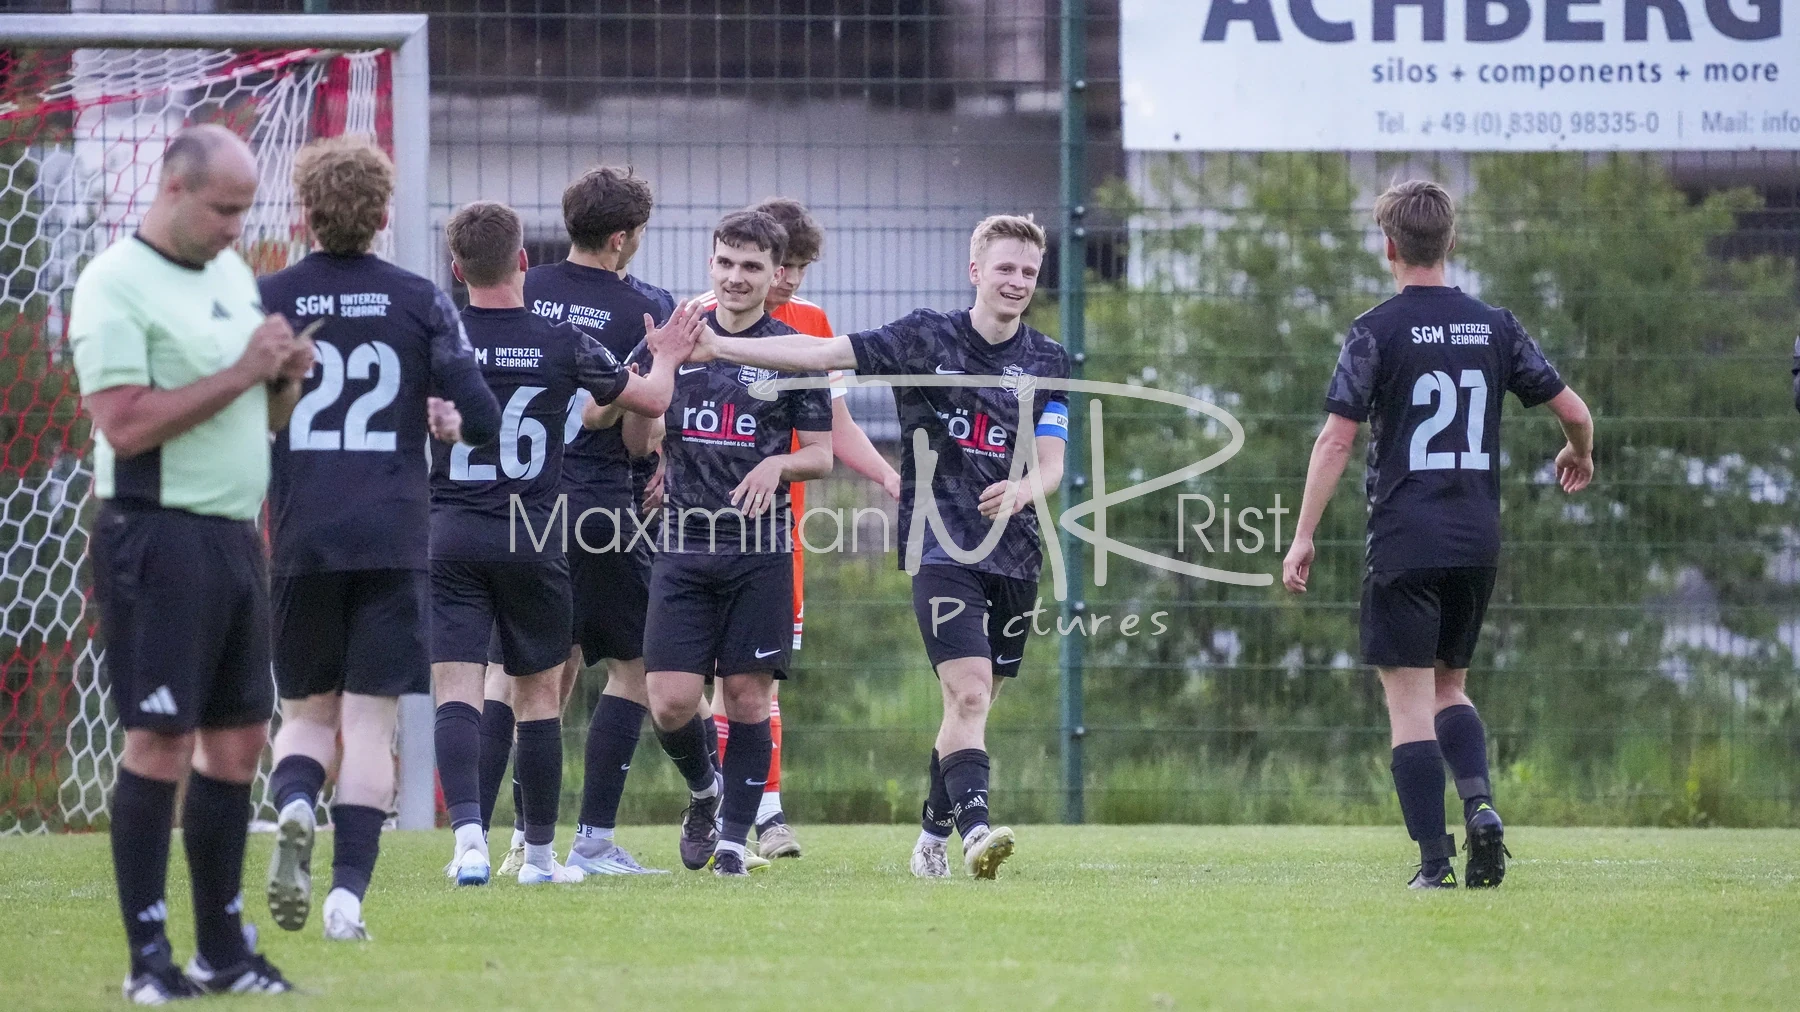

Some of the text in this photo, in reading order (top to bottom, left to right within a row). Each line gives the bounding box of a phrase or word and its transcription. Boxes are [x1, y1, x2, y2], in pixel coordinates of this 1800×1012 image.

[1201, 0, 1783, 42] ACHBERG
[1371, 57, 1780, 89] silos + components + more
[1508, 111, 1562, 134] 8380
[1570, 111, 1659, 134] 98335-0
[296, 294, 335, 316] SGM
[340, 292, 391, 306] UNTERZEIL
[531, 299, 564, 320] SGM
[569, 304, 611, 321] UNTERZEIL
[566, 314, 605, 330] SEIBRANZ
[1449, 323, 1492, 335] UNTERZEIL
[1411, 325, 1445, 344] SGM
[1450, 334, 1489, 346] SEIBRANZ
[495, 347, 543, 358] UNTERZEIL
[495, 358, 539, 368] SEIBRANZ
[289, 340, 401, 452] 22
[682, 400, 757, 437] rölle
[1409, 369, 1490, 471] 21
